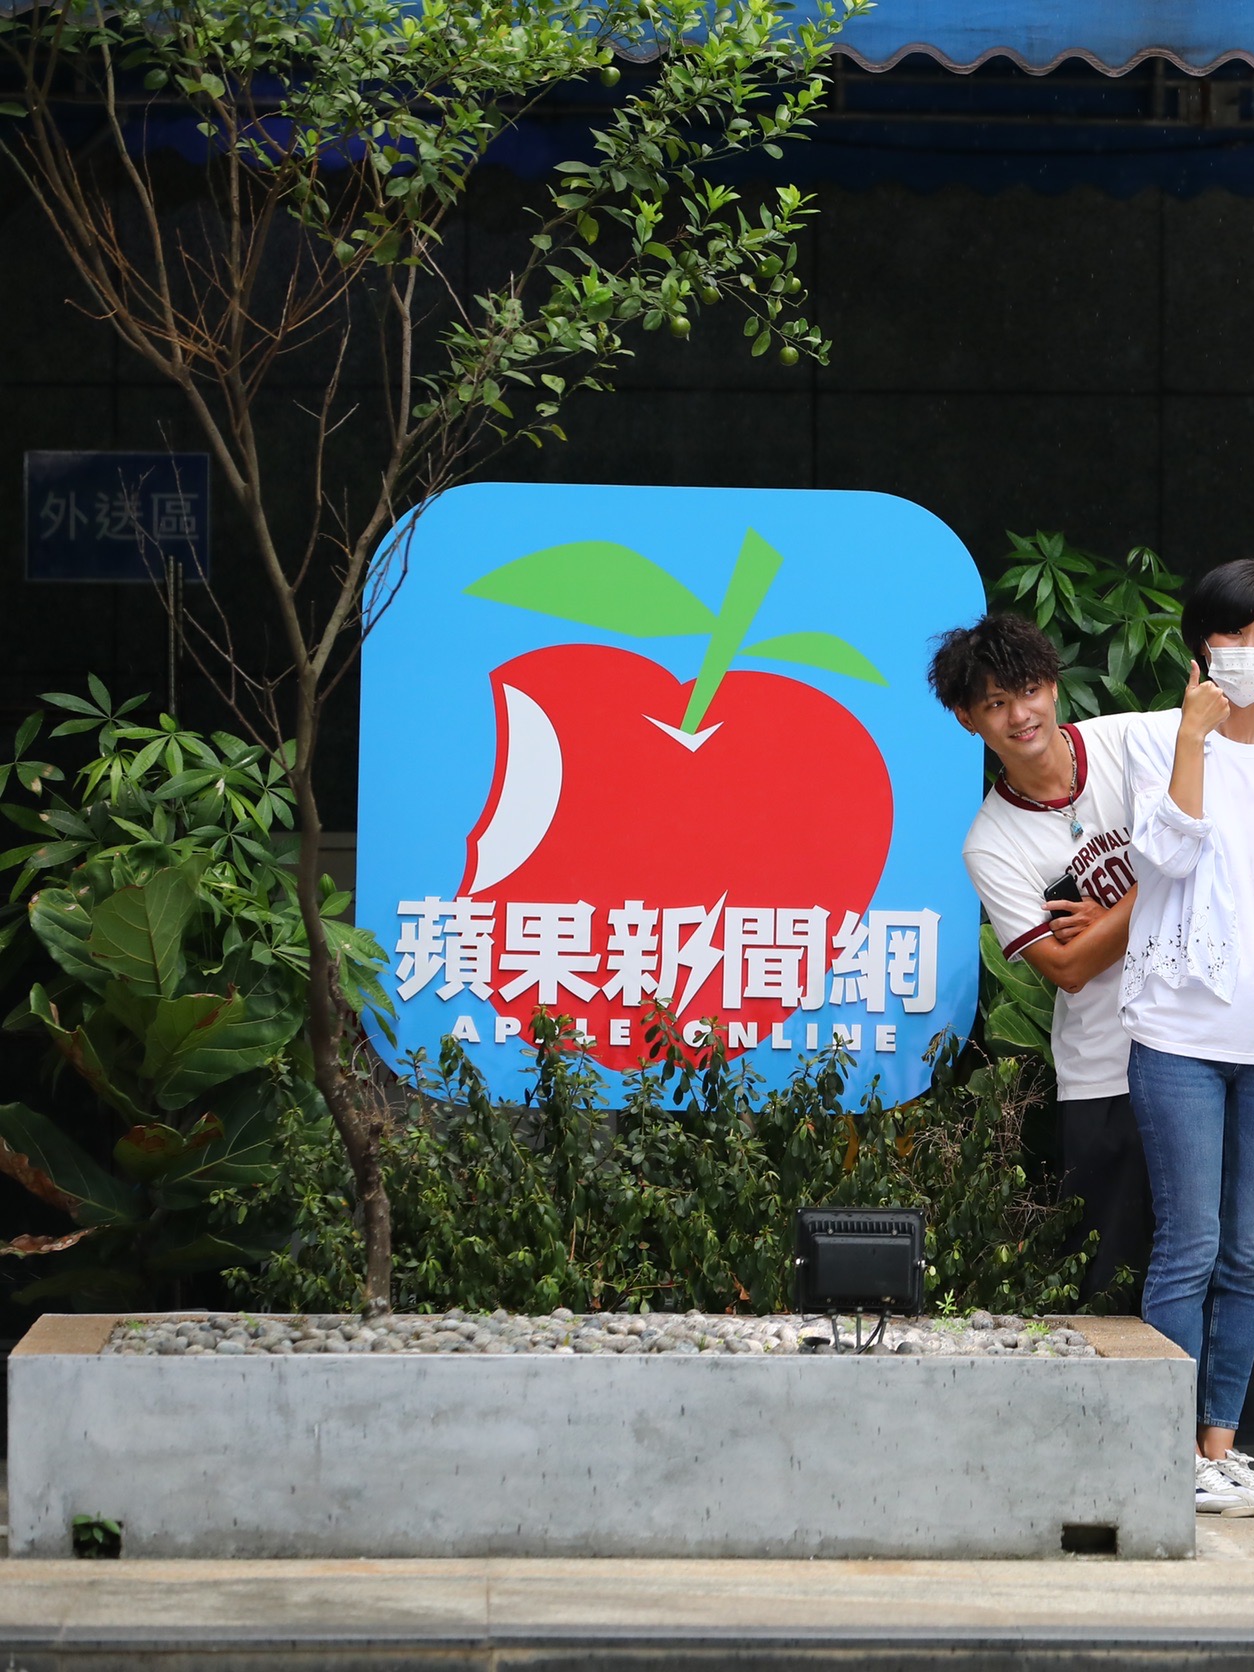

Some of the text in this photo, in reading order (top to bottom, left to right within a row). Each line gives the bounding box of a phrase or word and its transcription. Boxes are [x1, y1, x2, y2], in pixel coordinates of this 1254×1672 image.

[39, 491, 199, 541] 外送區
[1065, 827, 1131, 882] CORNWAL
[1082, 851, 1138, 909] 160
[394, 890, 942, 1023] 蘋果新聞網
[682, 1019, 897, 1051] ONLINE
